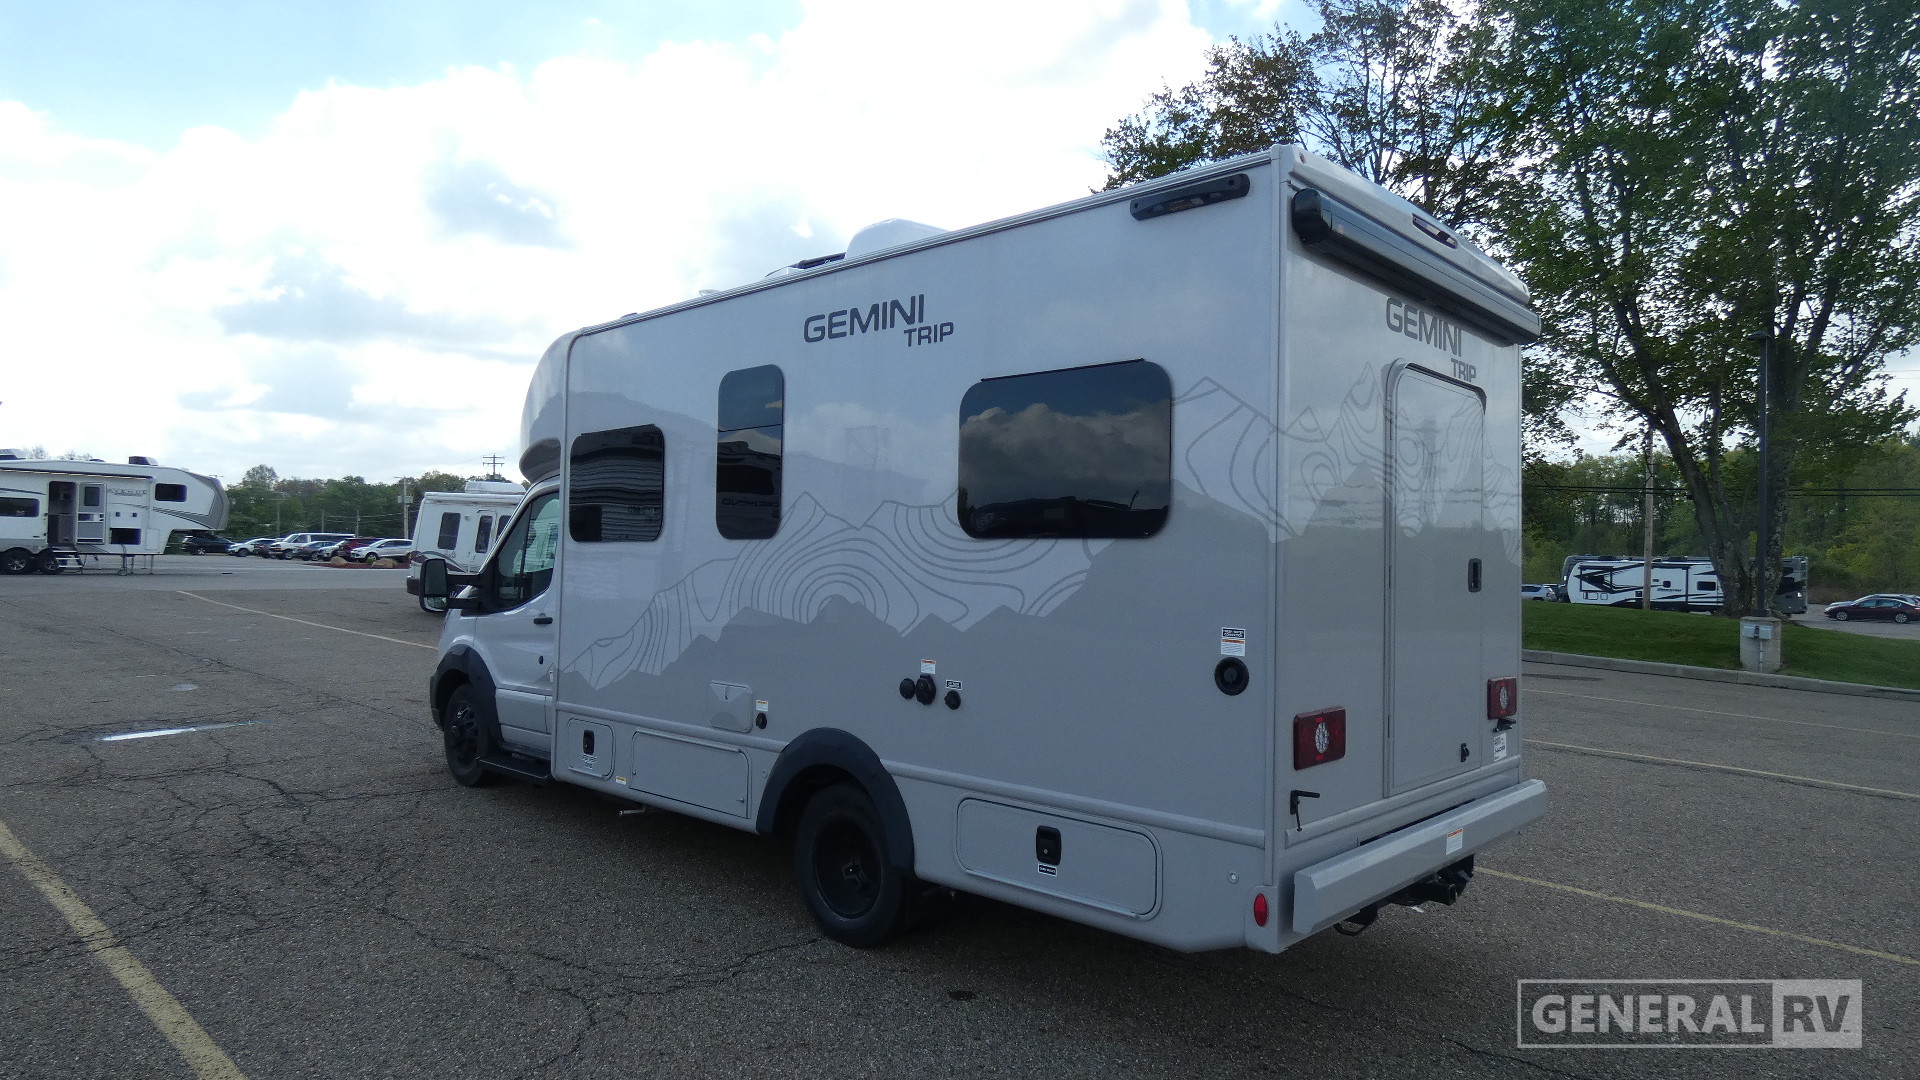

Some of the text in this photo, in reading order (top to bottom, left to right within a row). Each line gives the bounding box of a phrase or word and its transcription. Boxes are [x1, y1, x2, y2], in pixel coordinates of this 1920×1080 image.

[803, 293, 925, 343] GEMINI
[903, 321, 954, 347] TRIP
[1386, 297, 1462, 357] GEMINI
[1450, 357, 1477, 382] TRIP
